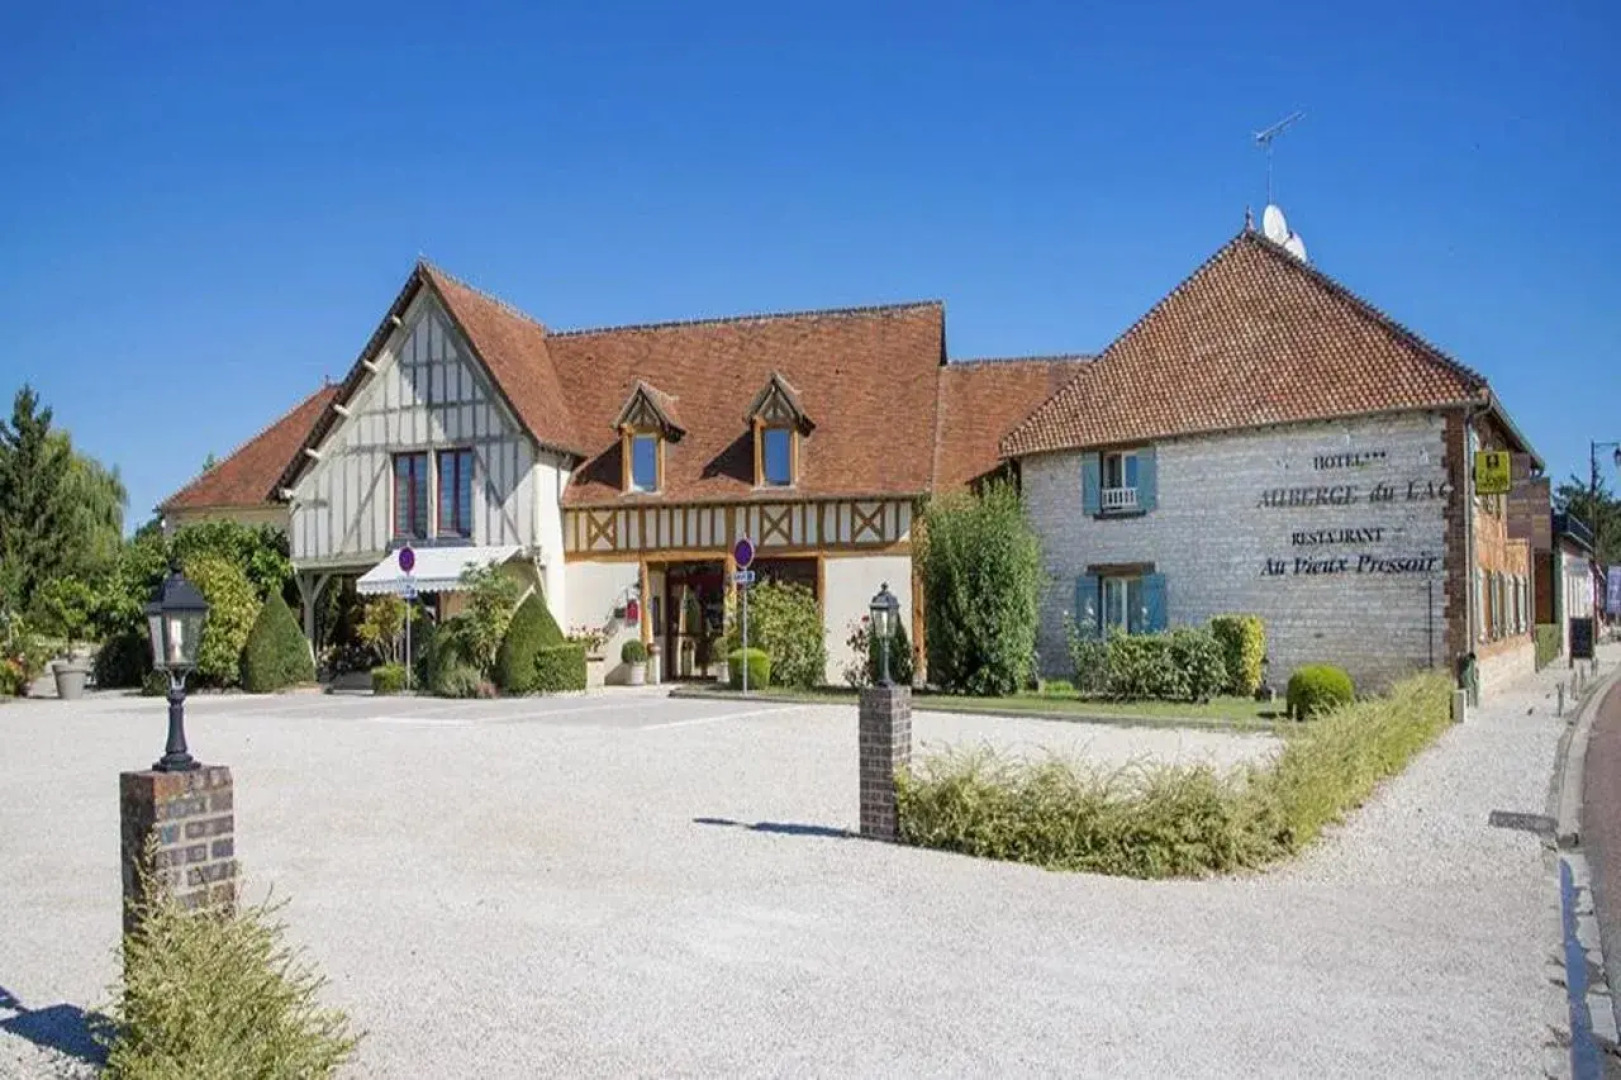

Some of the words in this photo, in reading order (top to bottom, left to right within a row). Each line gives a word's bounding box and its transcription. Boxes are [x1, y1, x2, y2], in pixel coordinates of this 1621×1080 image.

[1256, 485, 1358, 508] AUBERGE
[1369, 480, 1394, 502] du
[1291, 527, 1385, 546] RESTAURANT
[1260, 556, 1286, 576] Au
[1293, 555, 1348, 575] Vieux
[1356, 551, 1437, 574] Pressoir
